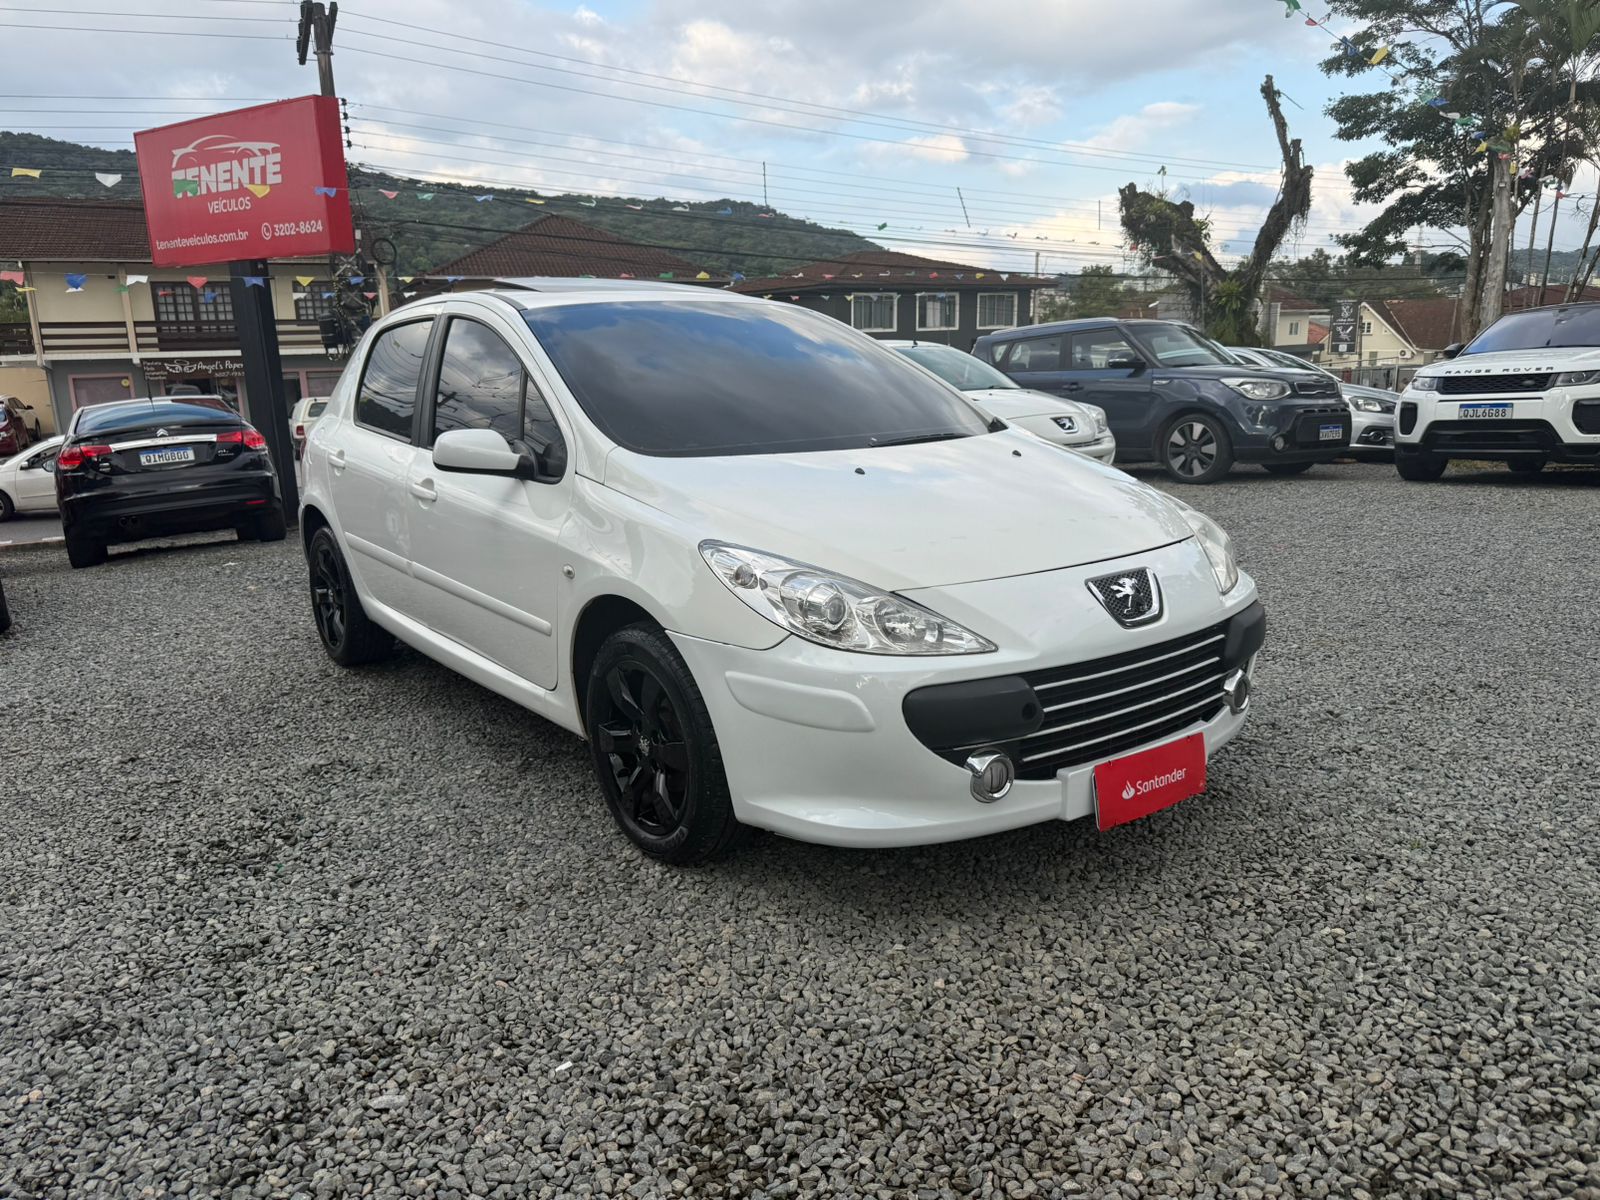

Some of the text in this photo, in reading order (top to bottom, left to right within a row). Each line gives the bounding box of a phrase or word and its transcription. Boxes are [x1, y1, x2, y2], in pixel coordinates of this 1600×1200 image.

[207, 196, 252, 214] VEÍCULOS
[273, 220, 323, 237] 3202-8624
[197, 361, 224, 374] Angel's
[1463, 408, 1507, 418] QJL6G88
[1136, 767, 1187, 796] Santander
